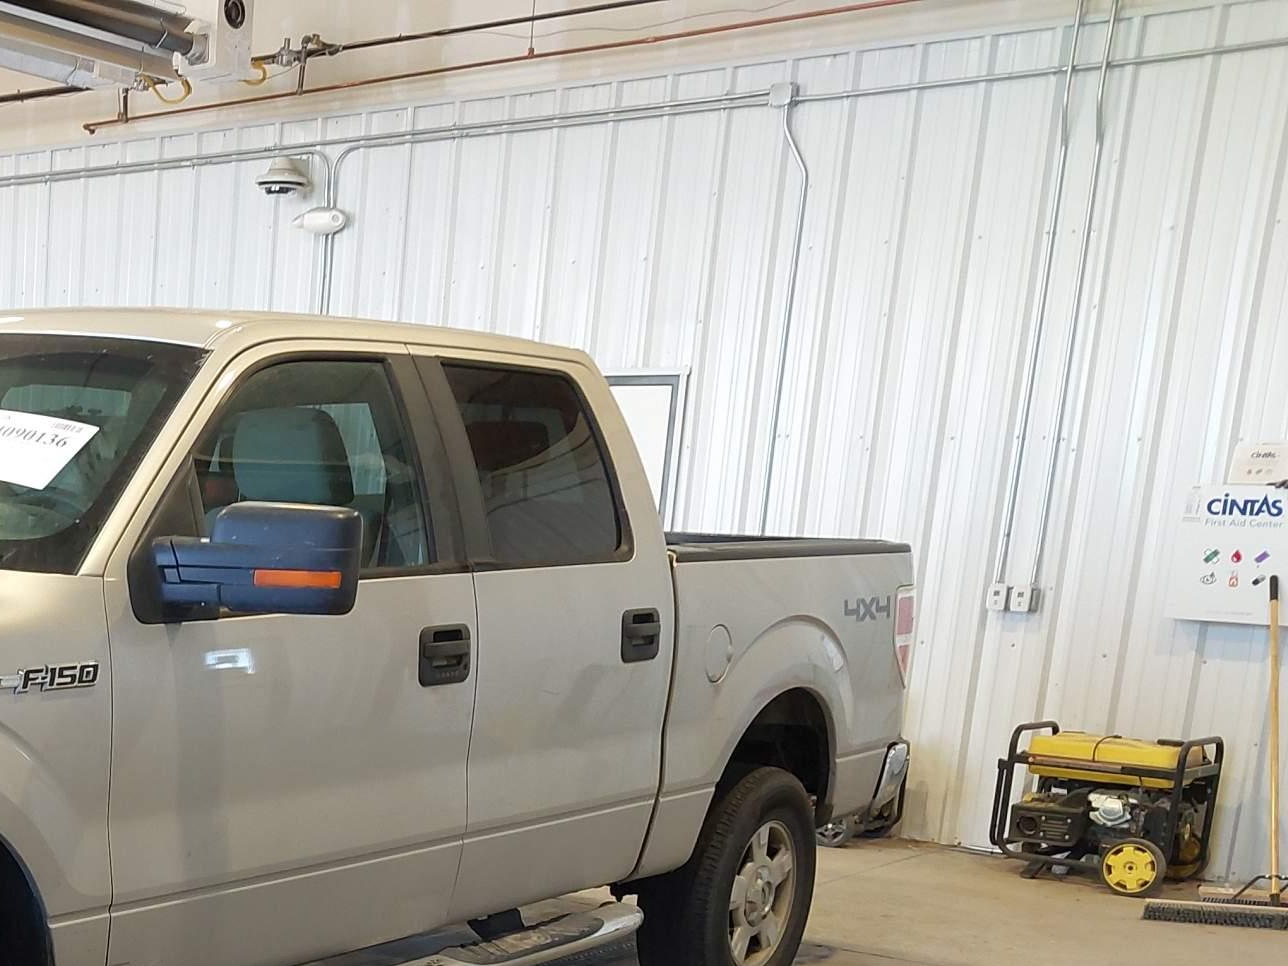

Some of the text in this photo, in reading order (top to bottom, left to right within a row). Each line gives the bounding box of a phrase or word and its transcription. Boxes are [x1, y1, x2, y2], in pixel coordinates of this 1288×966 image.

[1206, 493, 1284, 517] CINTAS
[1205, 517, 1226, 527] First
[1229, 518, 1246, 527] Aid
[1249, 519, 1283, 529] Center
